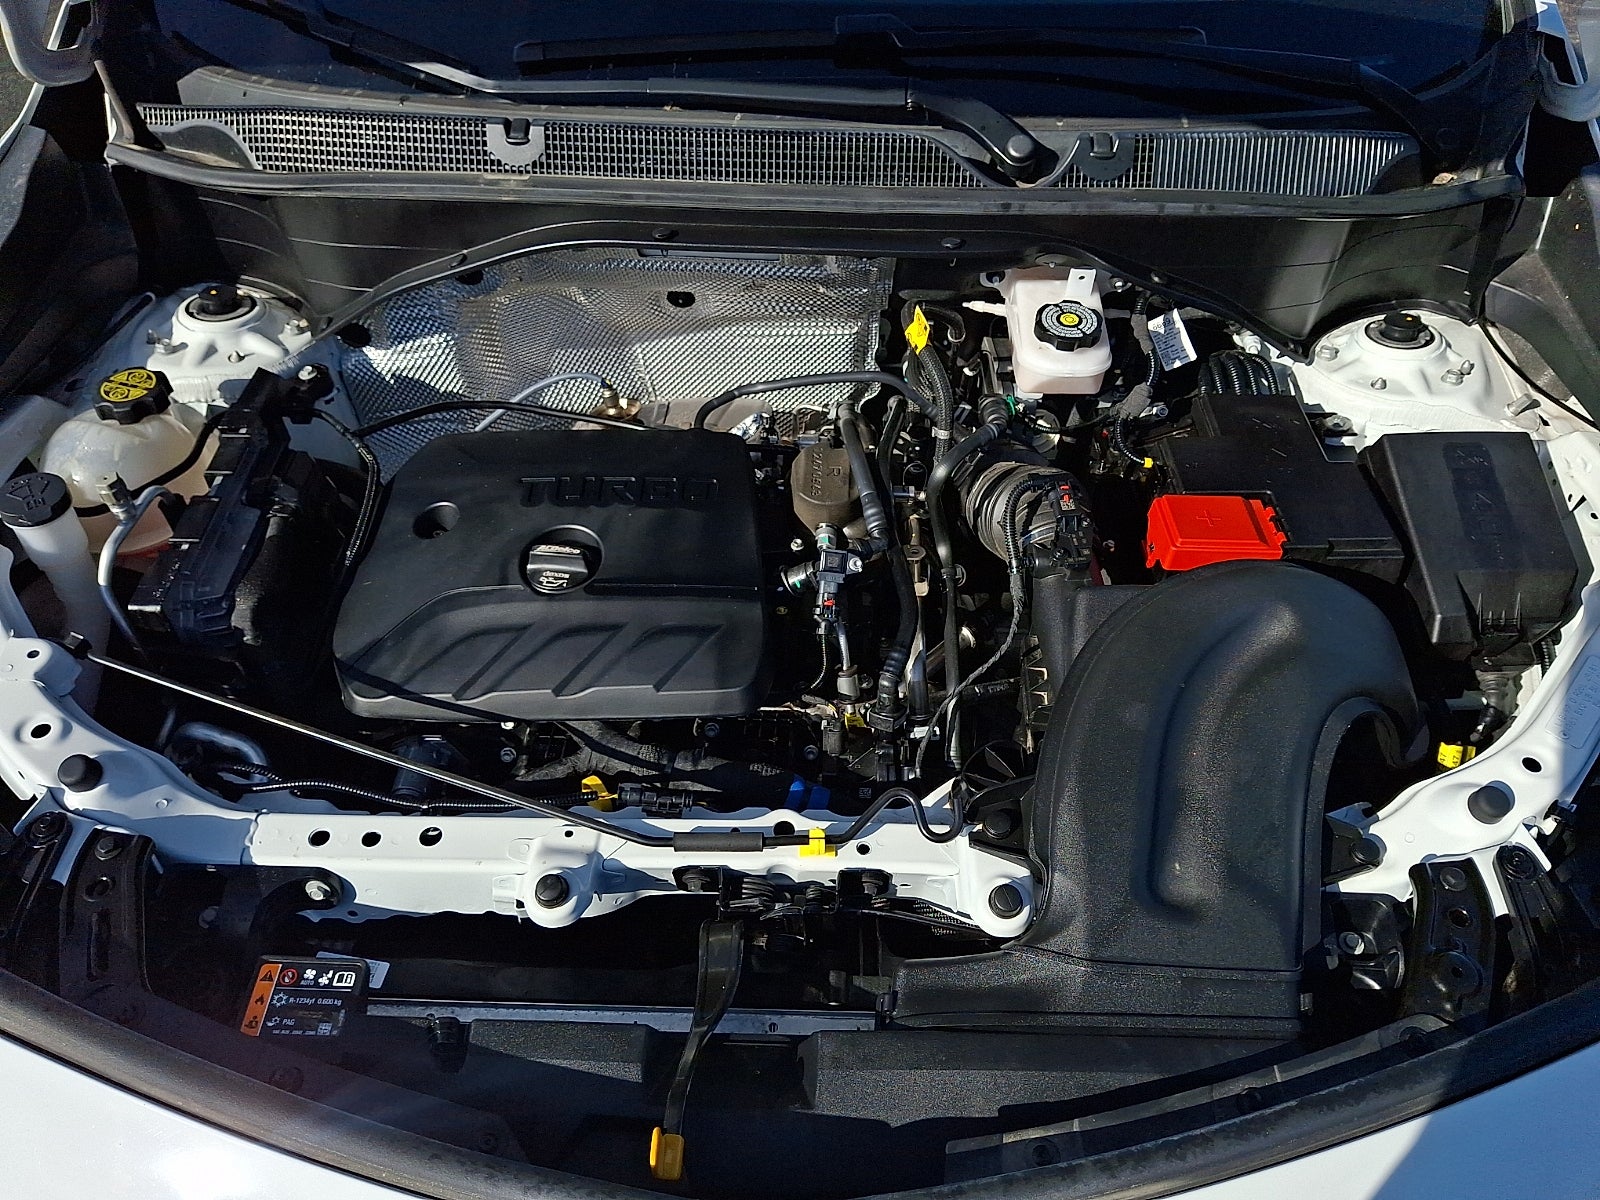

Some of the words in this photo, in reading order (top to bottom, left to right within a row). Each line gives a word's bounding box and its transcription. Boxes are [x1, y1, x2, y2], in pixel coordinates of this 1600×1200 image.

[520, 476, 719, 501] TURBO
[542, 570, 571, 579] dexos
[289, 997, 315, 1006] R-1234yf
[334, 998, 342, 1006] kg
[282, 1018, 296, 1026] PAG
